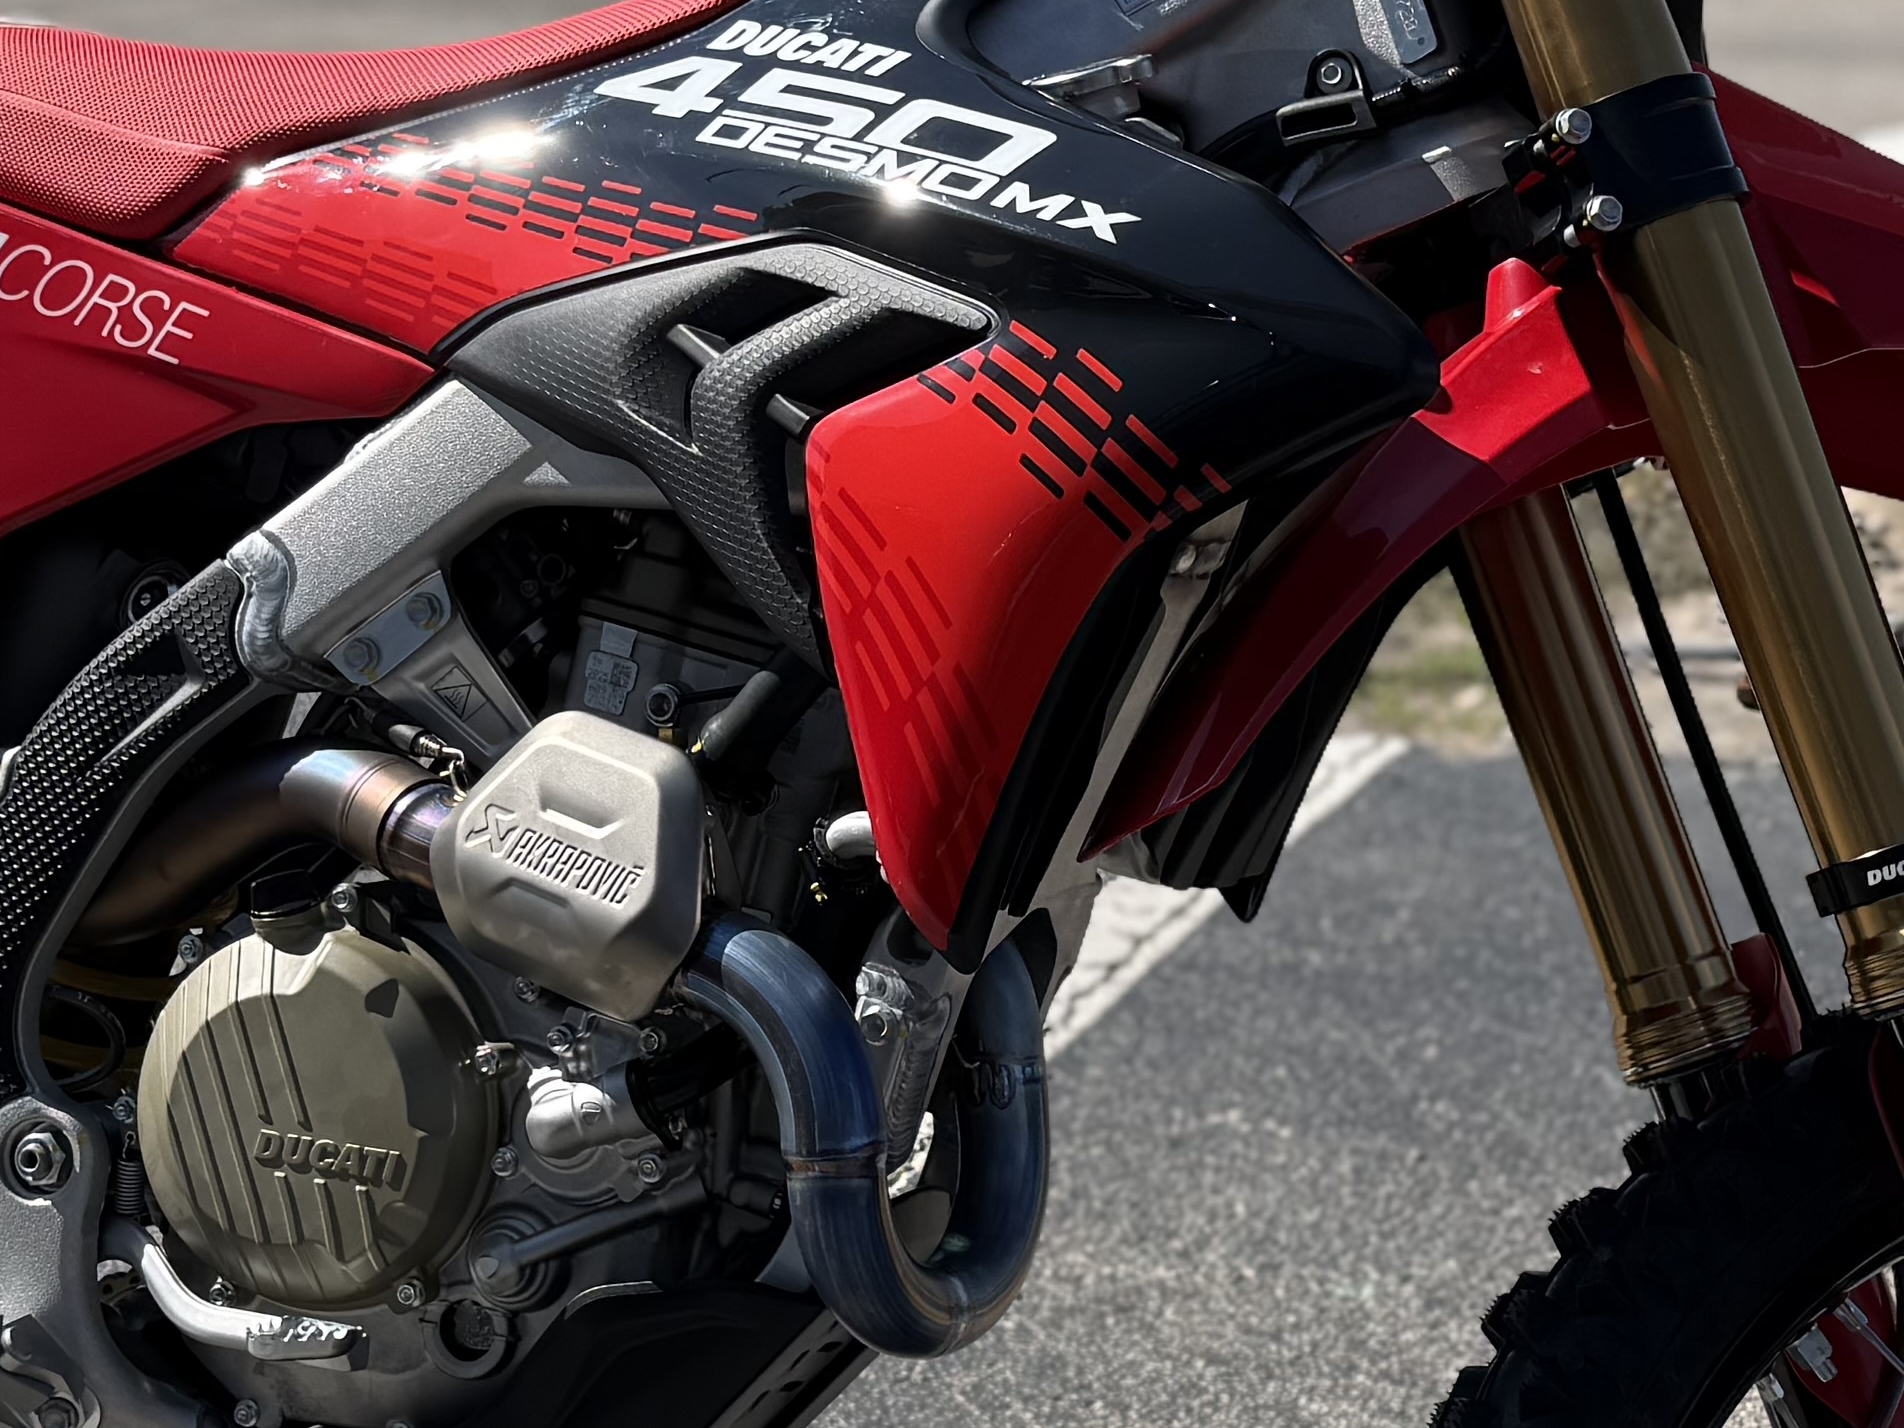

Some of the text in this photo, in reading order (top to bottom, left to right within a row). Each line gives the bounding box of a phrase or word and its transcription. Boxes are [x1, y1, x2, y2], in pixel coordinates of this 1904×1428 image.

[706, 19, 912, 78] DUCATI
[593, 55, 1058, 177] 450
[695, 115, 1142, 245] DESMO MX
[253, 1128, 409, 1193] DUCATI
